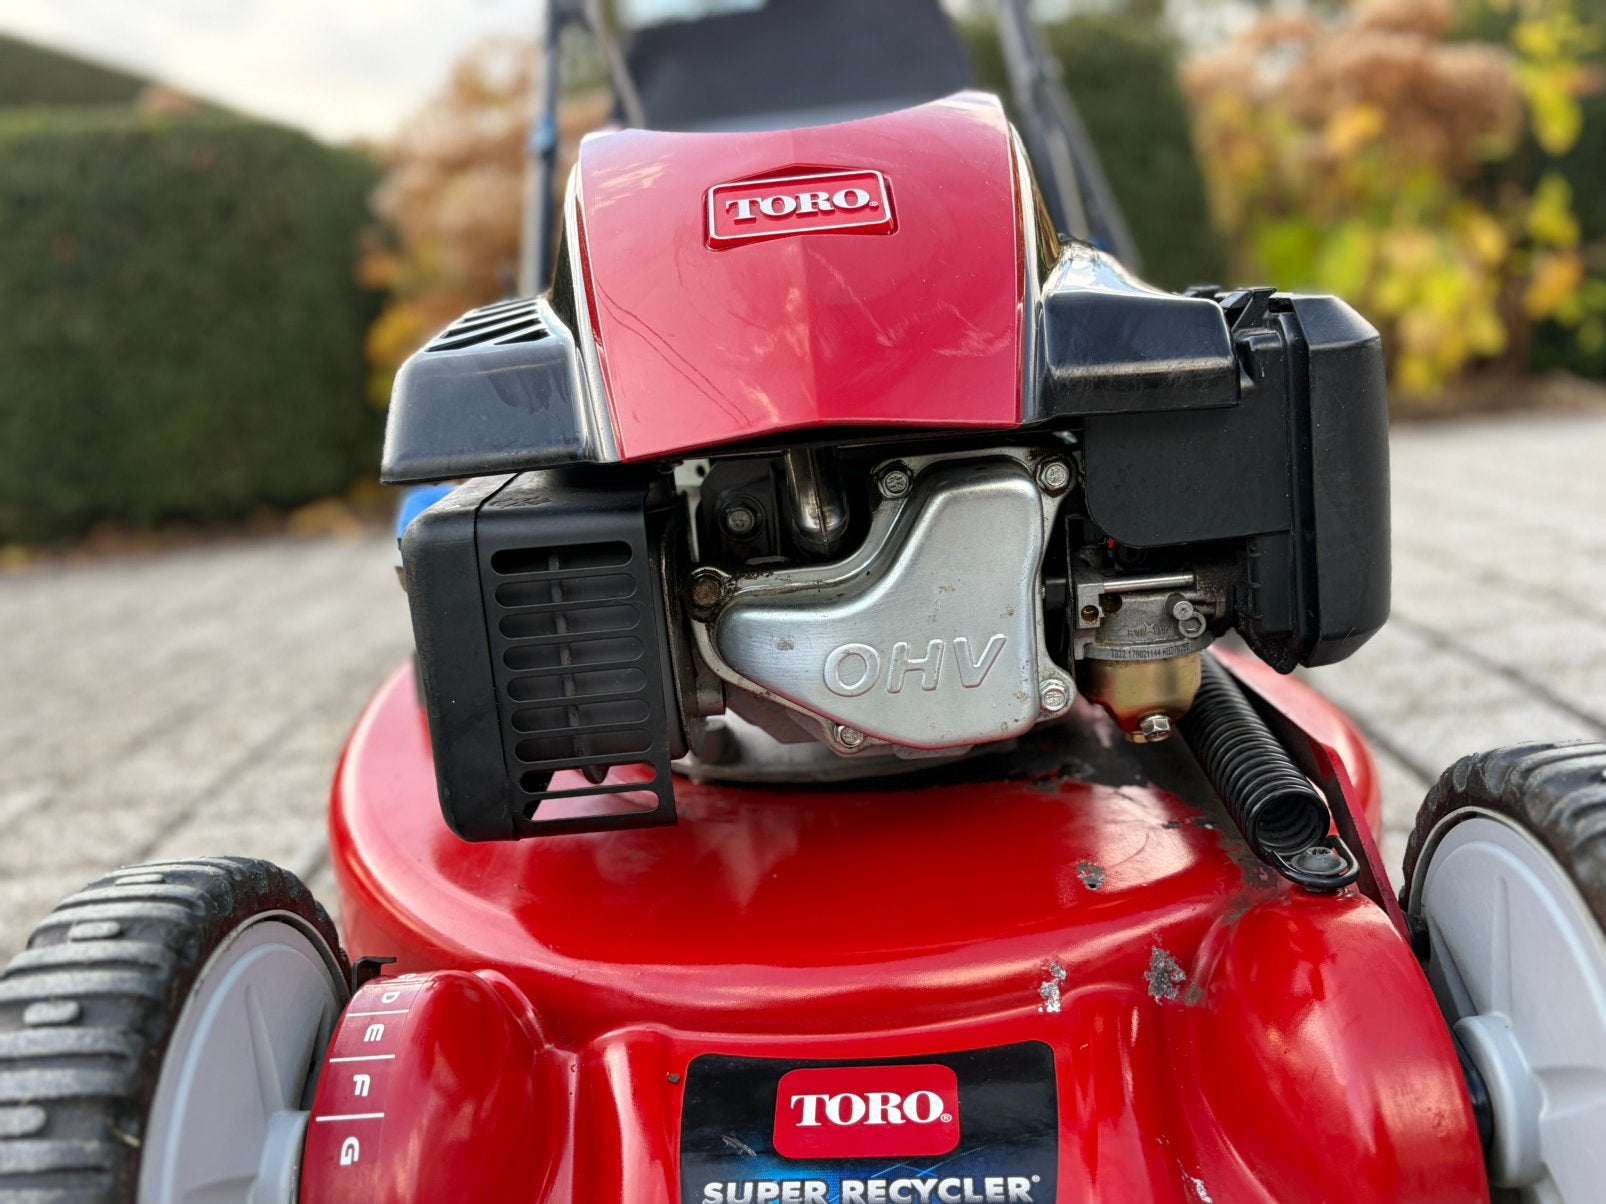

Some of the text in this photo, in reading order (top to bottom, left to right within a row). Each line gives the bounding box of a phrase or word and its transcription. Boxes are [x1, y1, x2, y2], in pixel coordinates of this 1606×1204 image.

[823, 633, 1008, 698] OHV
[381, 991, 401, 1004] D
[363, 1023, 385, 1042] E
[353, 1073, 371, 1097] F
[340, 1136, 360, 1166] G
[702, 1176, 1034, 1204] SUPER RECYCLER
